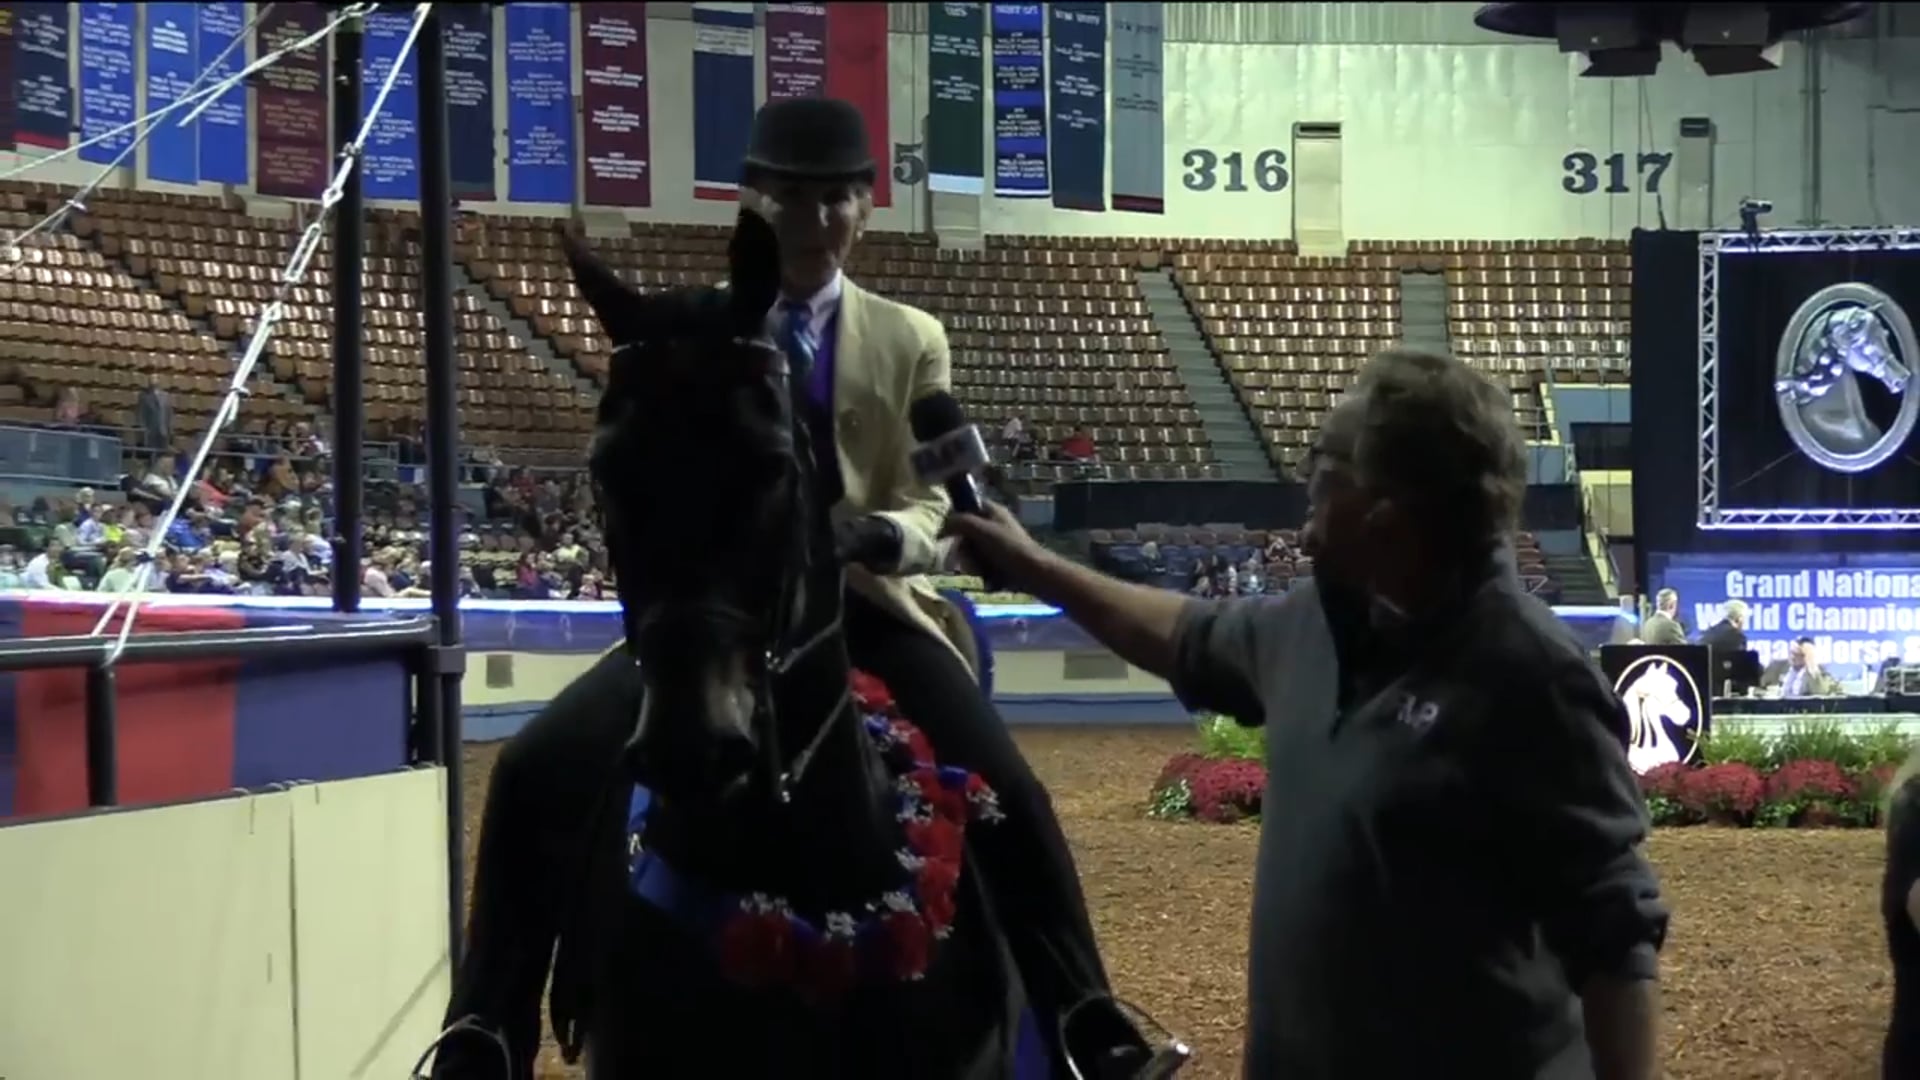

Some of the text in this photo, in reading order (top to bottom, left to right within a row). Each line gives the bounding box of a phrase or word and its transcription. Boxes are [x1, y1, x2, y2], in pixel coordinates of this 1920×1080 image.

[1182, 149, 1289, 192] 316
[1562, 152, 1673, 194] 317
[1726, 569, 1810, 598] Grand
[1695, 602, 1780, 631] Wrld
